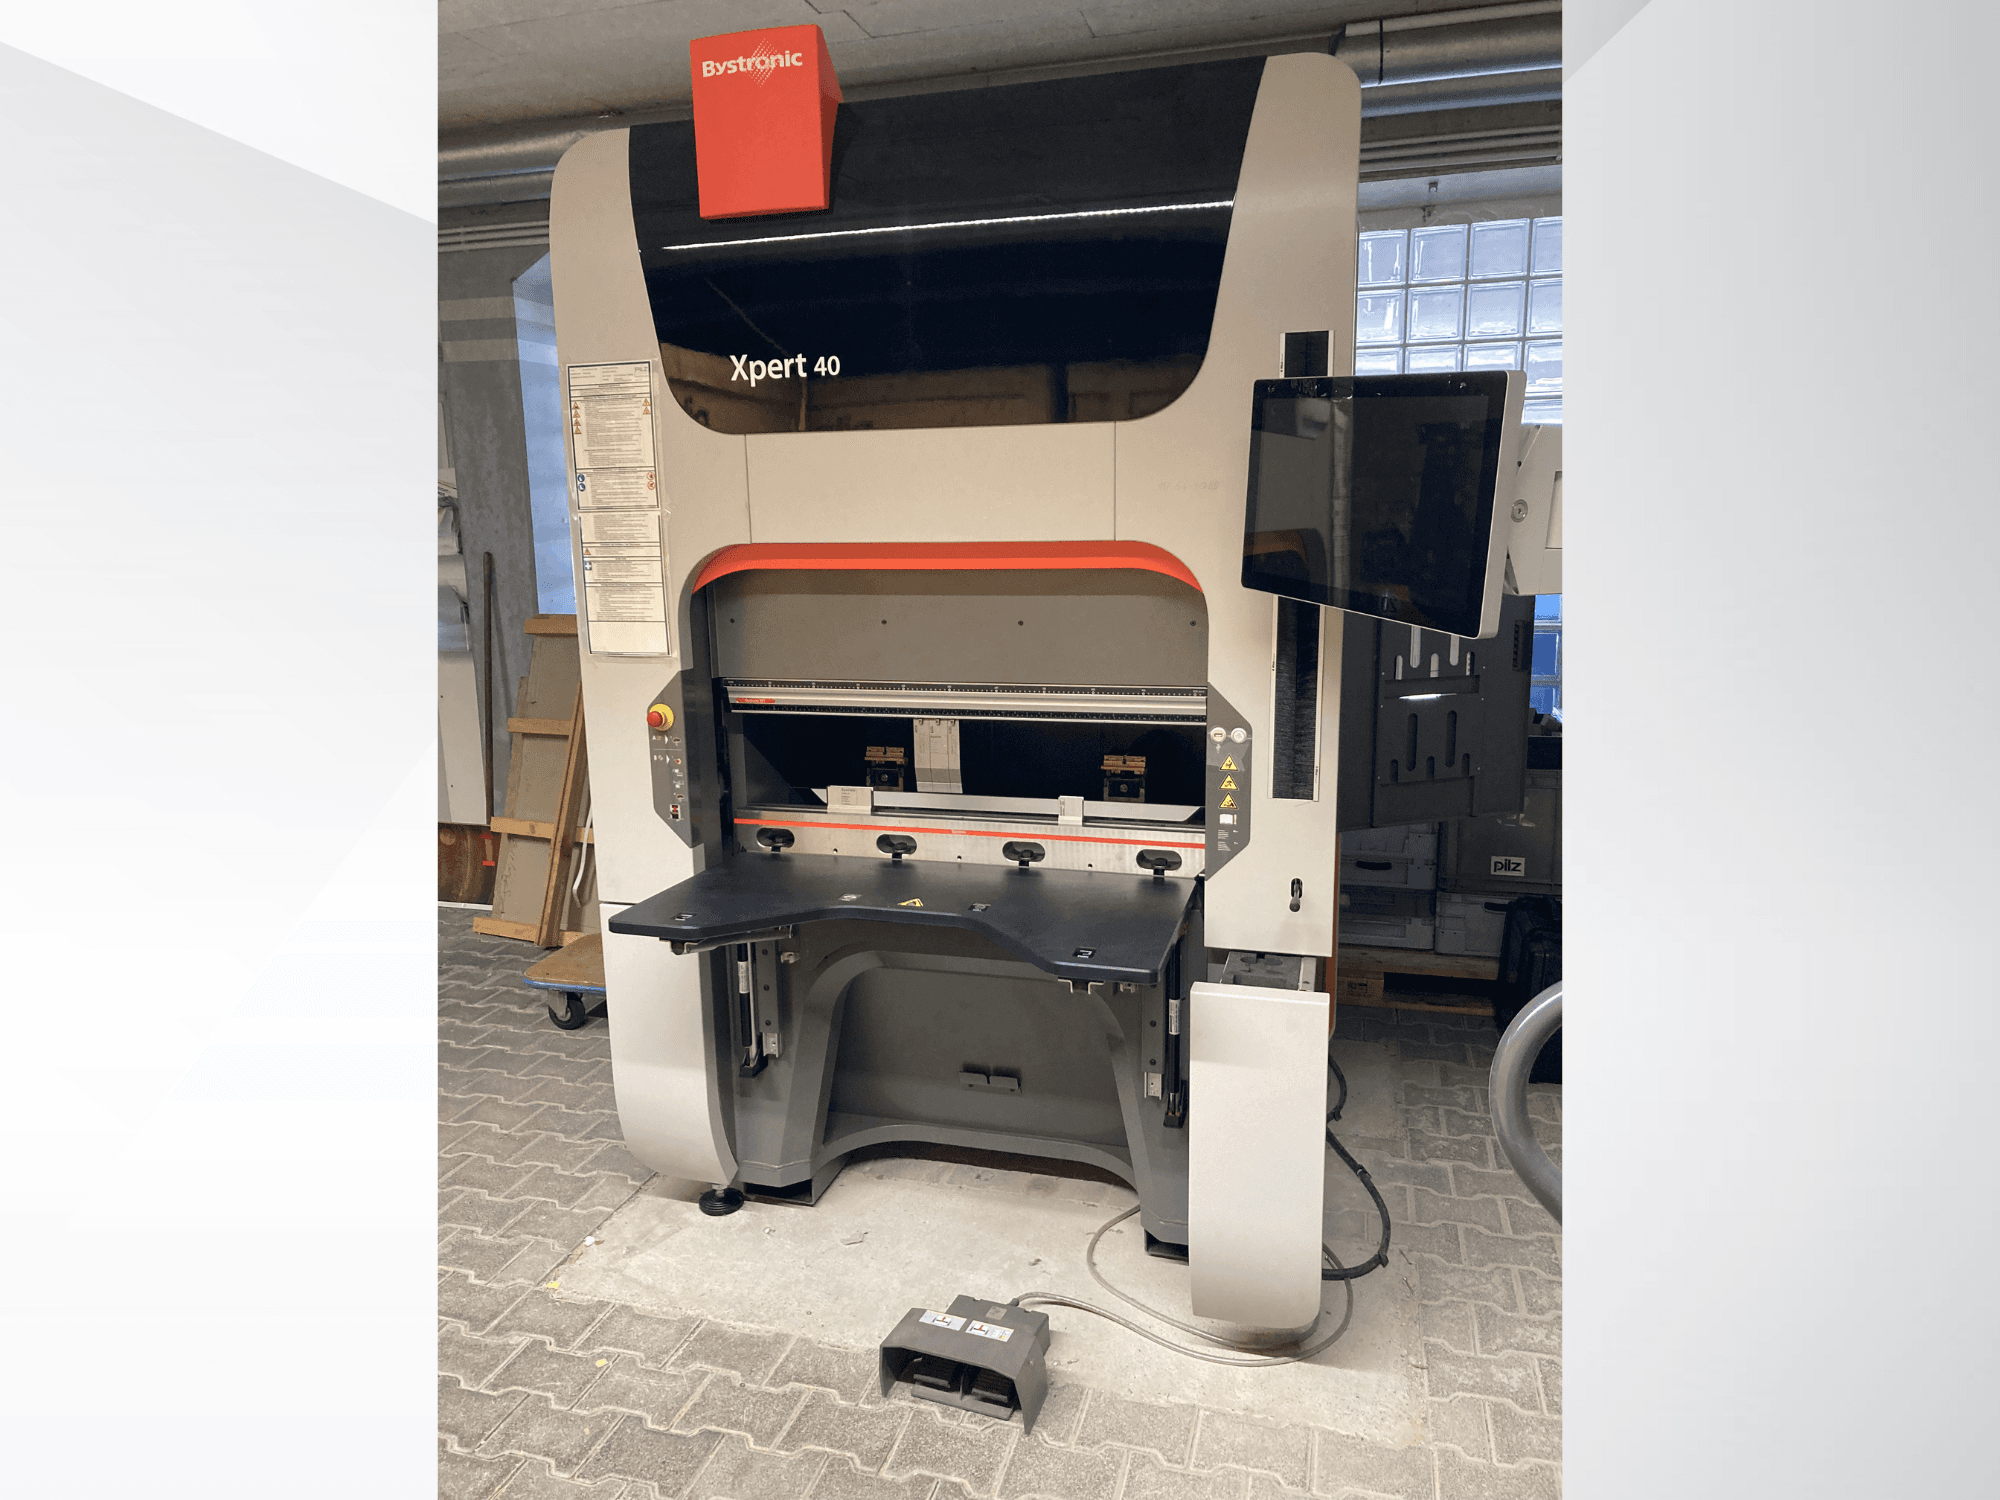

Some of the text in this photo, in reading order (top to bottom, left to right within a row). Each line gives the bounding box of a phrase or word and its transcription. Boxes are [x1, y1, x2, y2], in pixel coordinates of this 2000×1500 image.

[702, 50, 803, 77] Bystronic
[729, 353, 841, 387] Xpert 40
[1493, 858, 1522, 872] pilz
